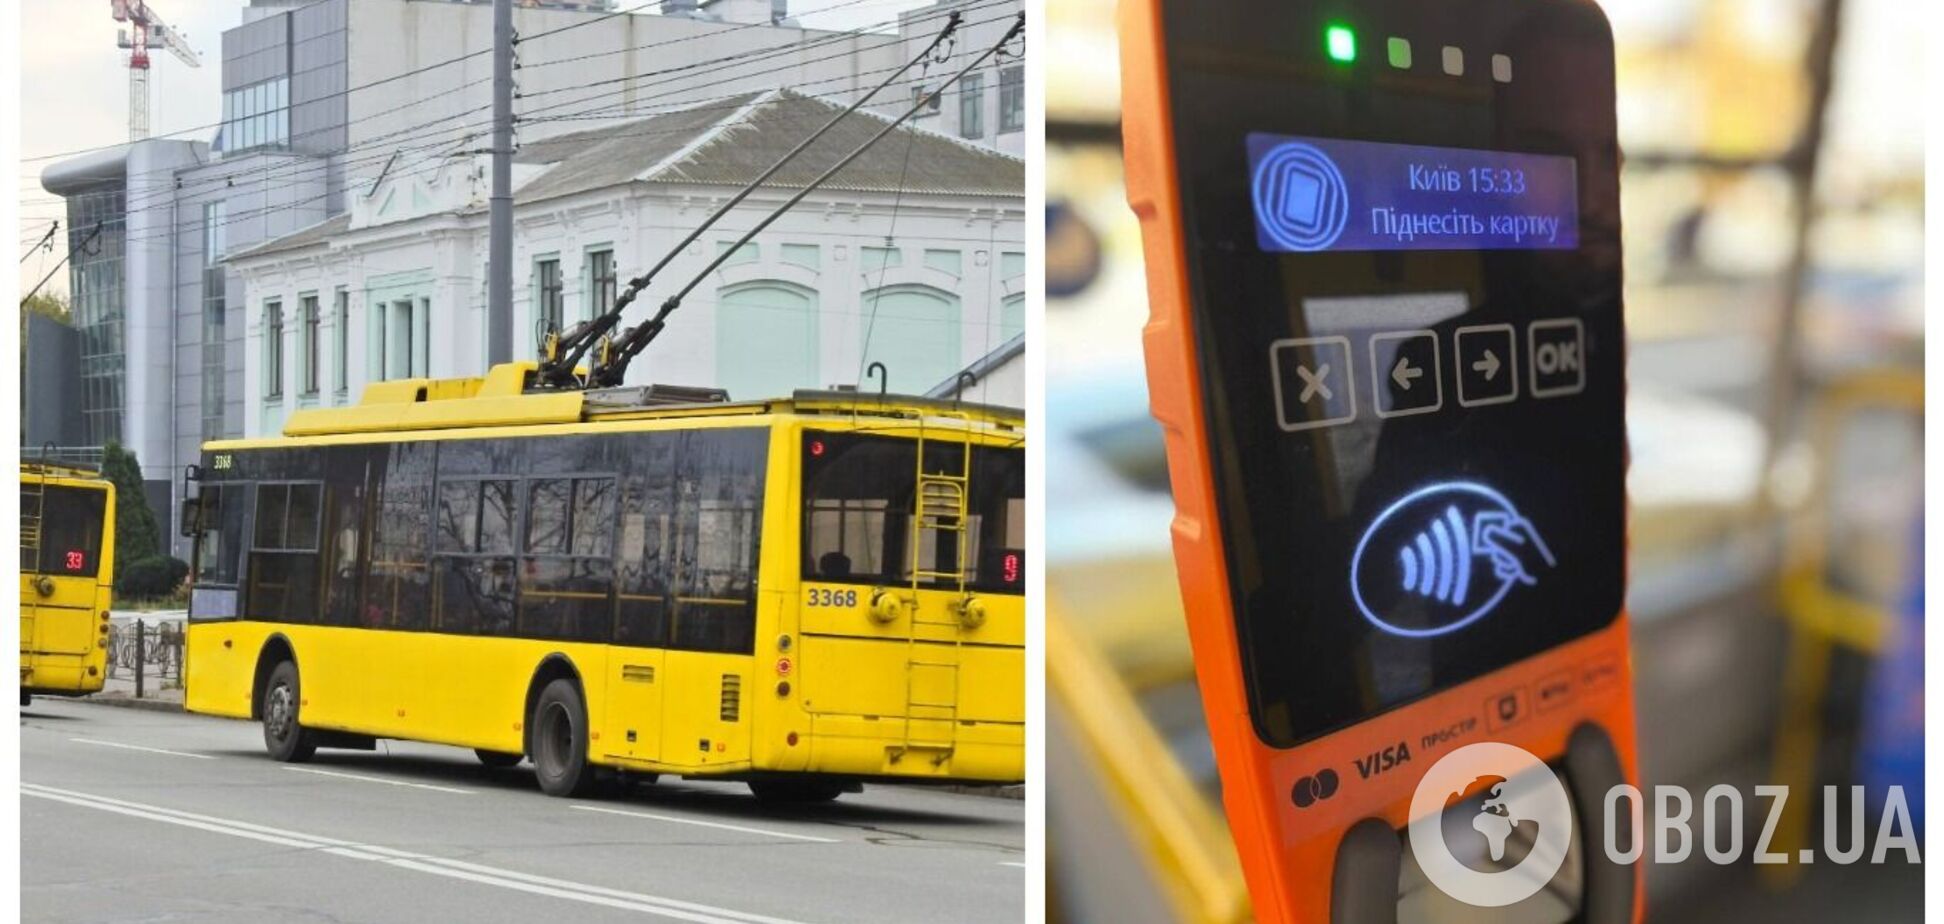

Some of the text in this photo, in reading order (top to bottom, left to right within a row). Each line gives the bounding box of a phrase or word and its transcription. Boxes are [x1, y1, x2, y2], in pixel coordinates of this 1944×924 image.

[1409, 163, 1525, 194] Київ 15:33
[1372, 206, 1559, 243] Піднесіть картку
[1537, 341, 1579, 374] OK
[66, 551, 82, 569] 33
[807, 588, 857, 608] 3368
[1353, 742, 1411, 779] VISA
